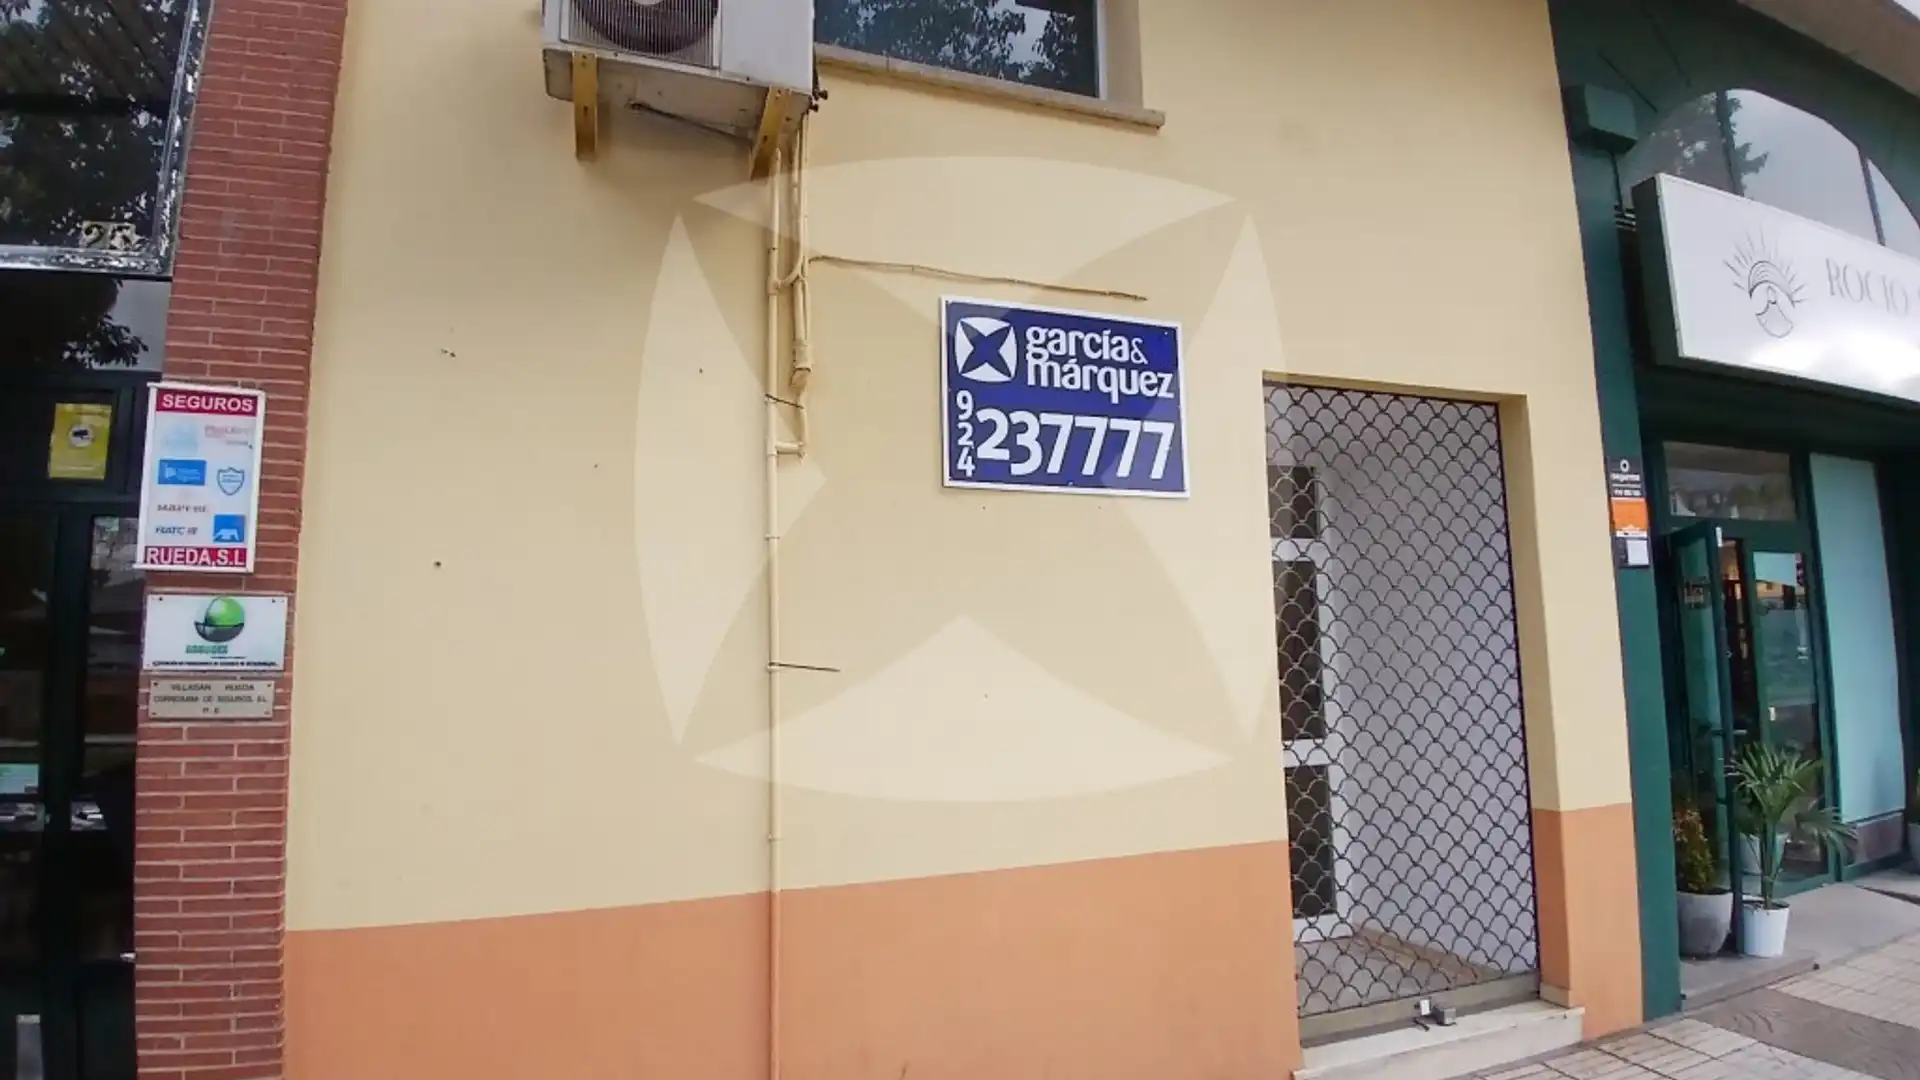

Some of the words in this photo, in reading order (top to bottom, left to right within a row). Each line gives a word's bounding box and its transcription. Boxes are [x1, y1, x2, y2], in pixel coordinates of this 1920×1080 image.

[162, 393, 253, 412] SEGUROS
[1026, 357, 1175, 405] márquez
[975, 407, 1176, 480] 237777
